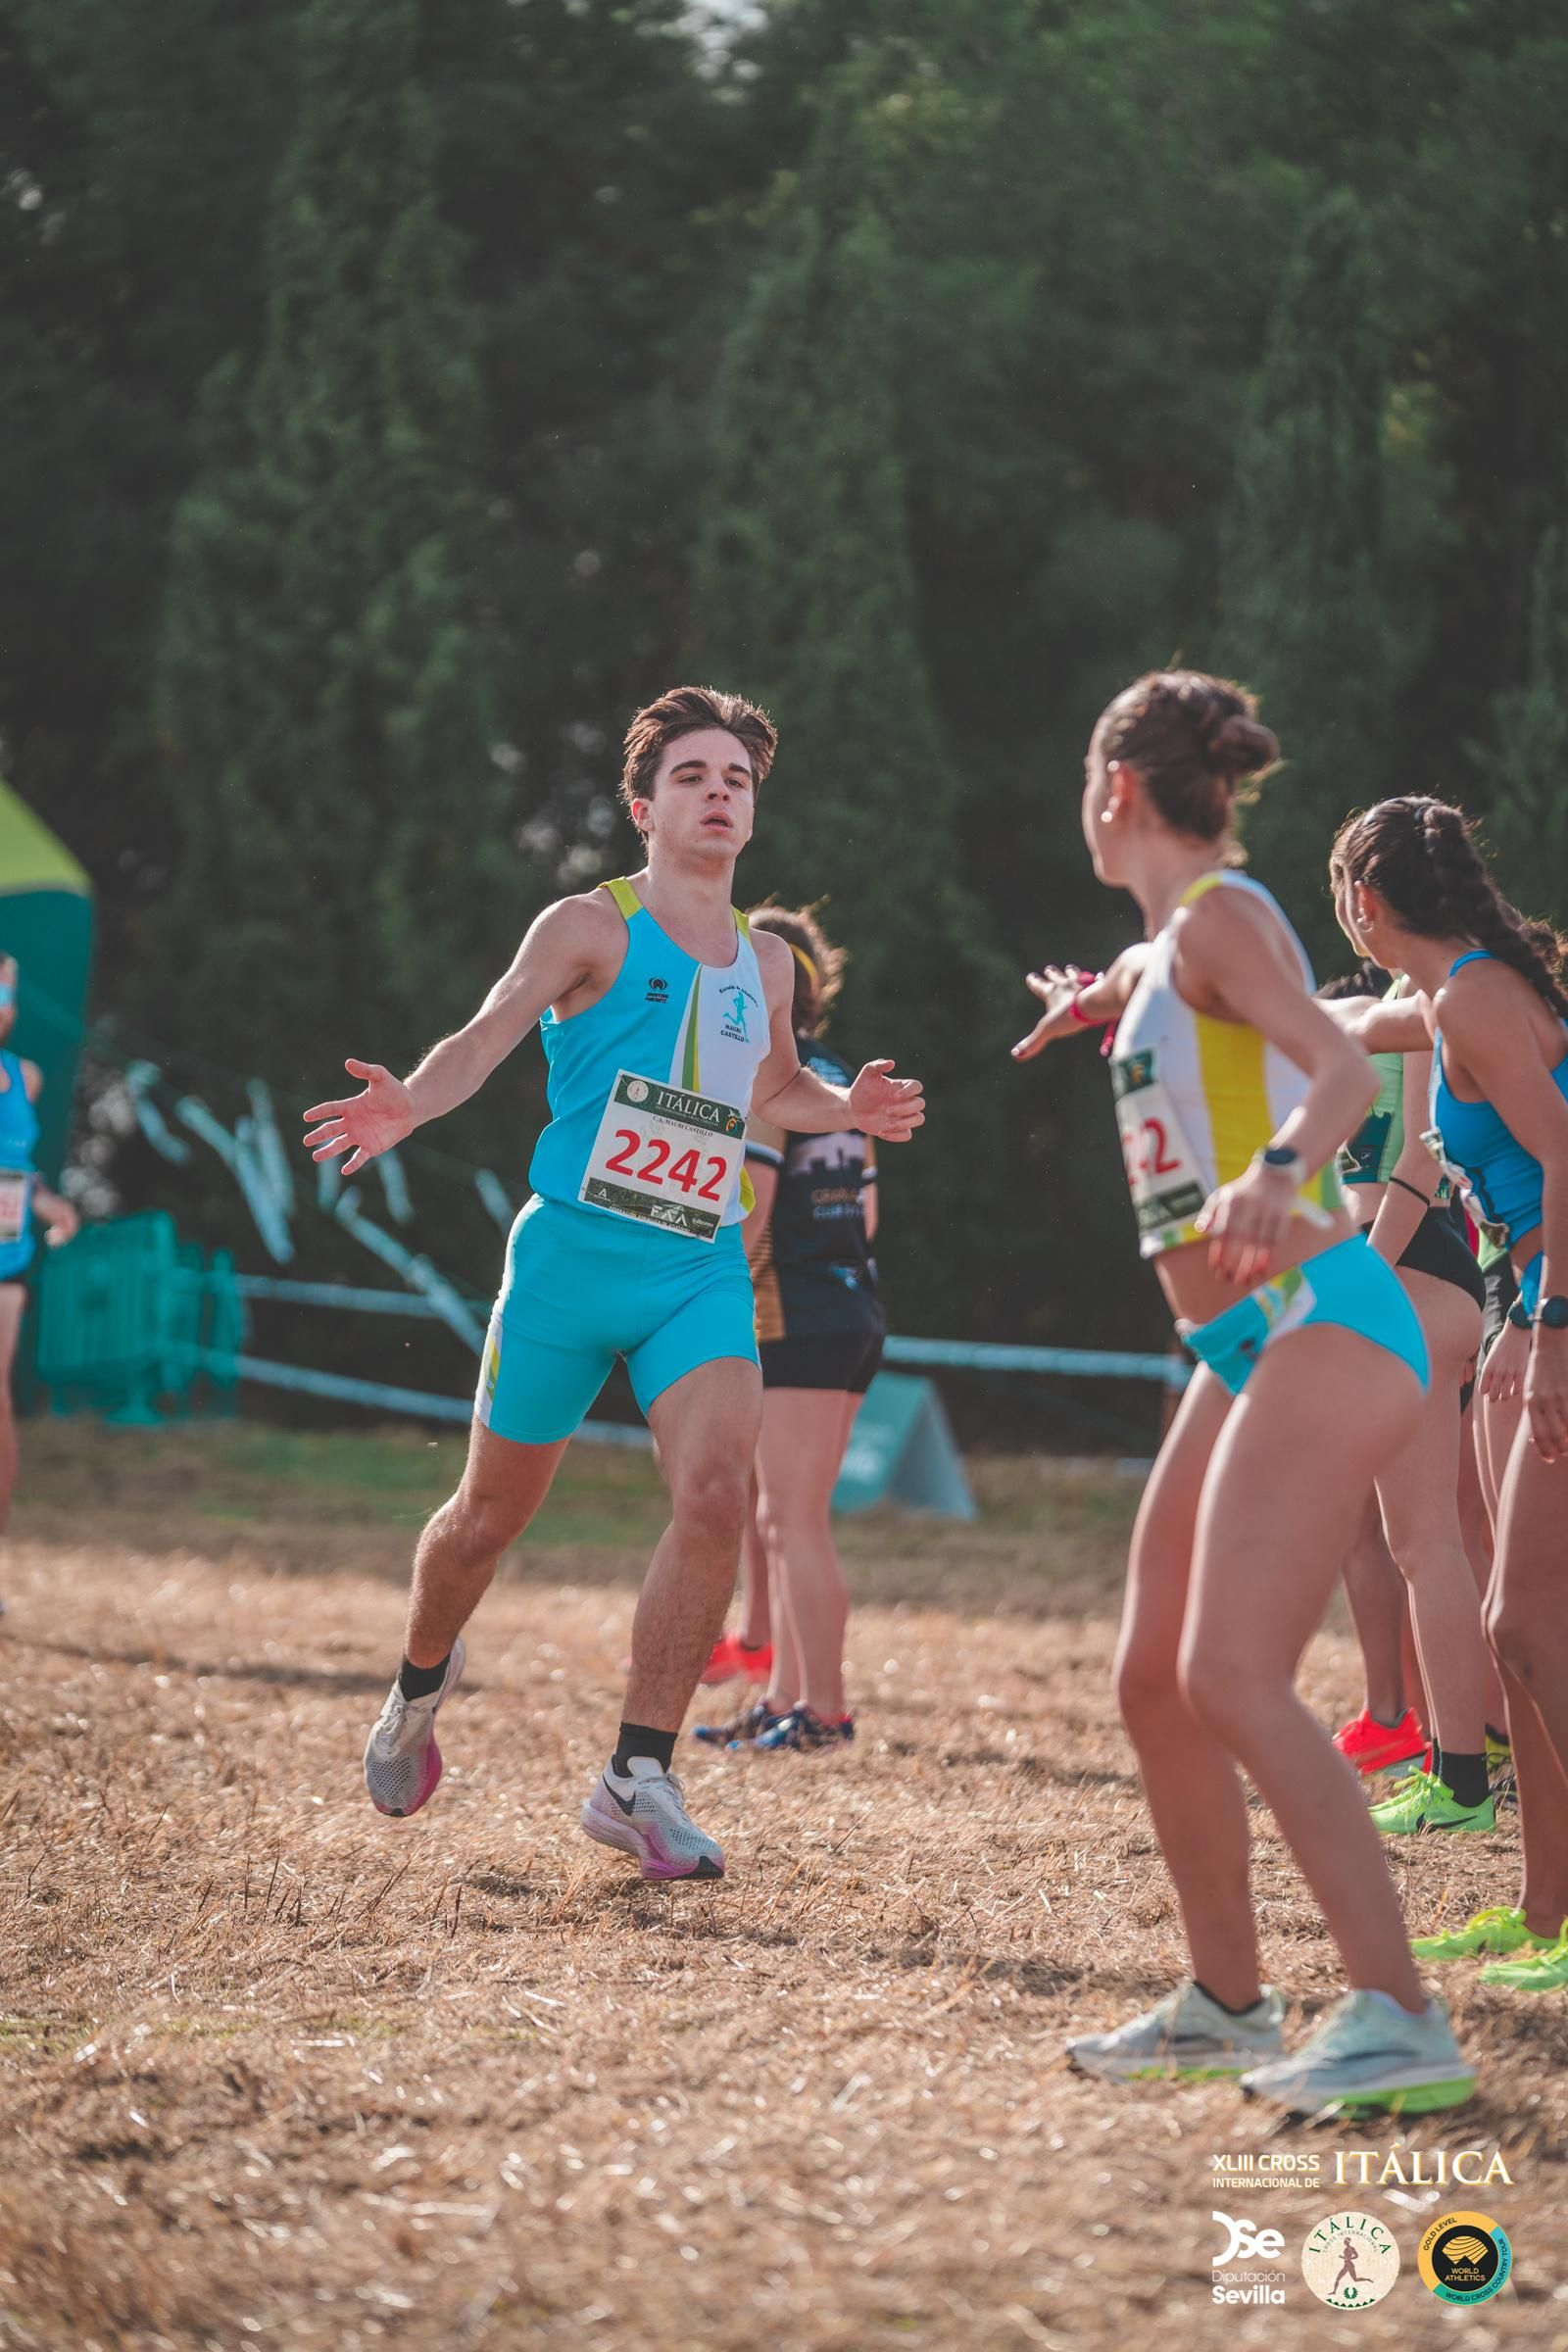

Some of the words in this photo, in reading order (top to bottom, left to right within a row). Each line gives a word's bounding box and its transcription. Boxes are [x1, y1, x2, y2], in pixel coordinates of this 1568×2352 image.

[657, 1091, 720, 1123] ITÁLICA
[684, 1124, 713, 1137] CASTILLO
[606, 1129, 727, 1201] 2242
